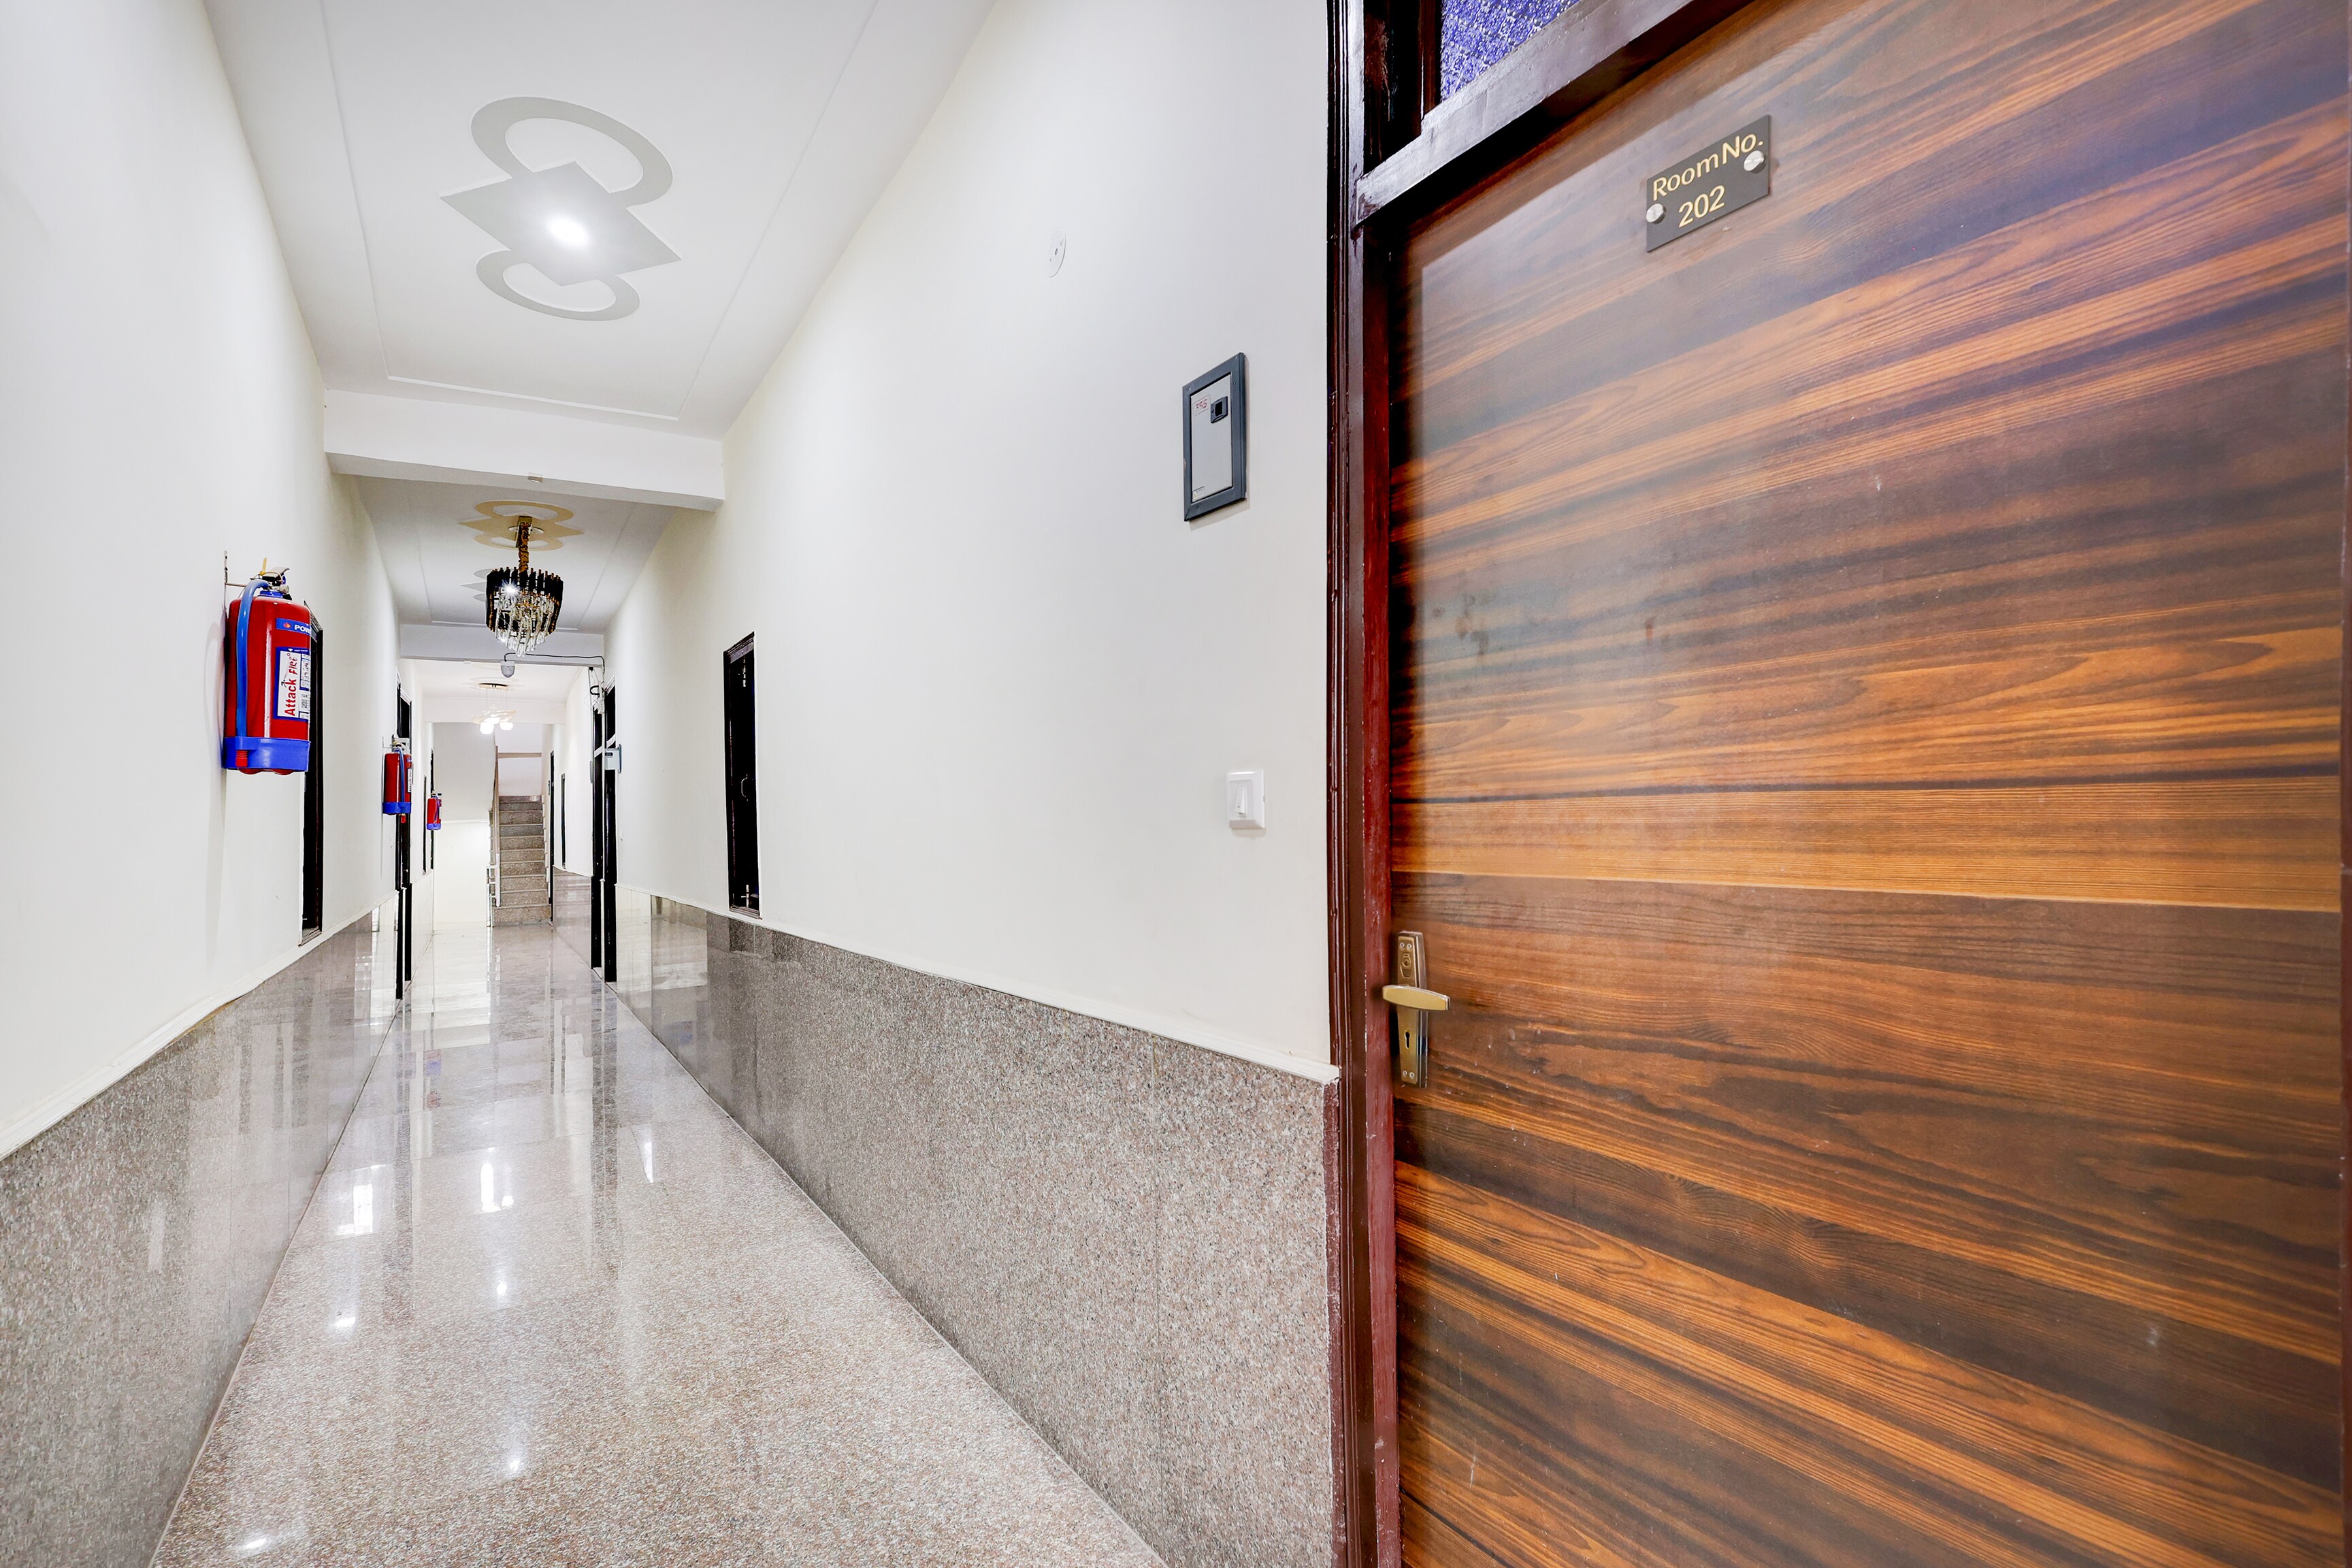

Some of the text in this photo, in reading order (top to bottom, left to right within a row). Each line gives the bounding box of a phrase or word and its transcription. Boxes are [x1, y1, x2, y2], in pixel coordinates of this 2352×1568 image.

[1653, 133, 1764, 201] Room No.
[1678, 185, 1725, 228] 202
[284, 679, 297, 716] Attack
